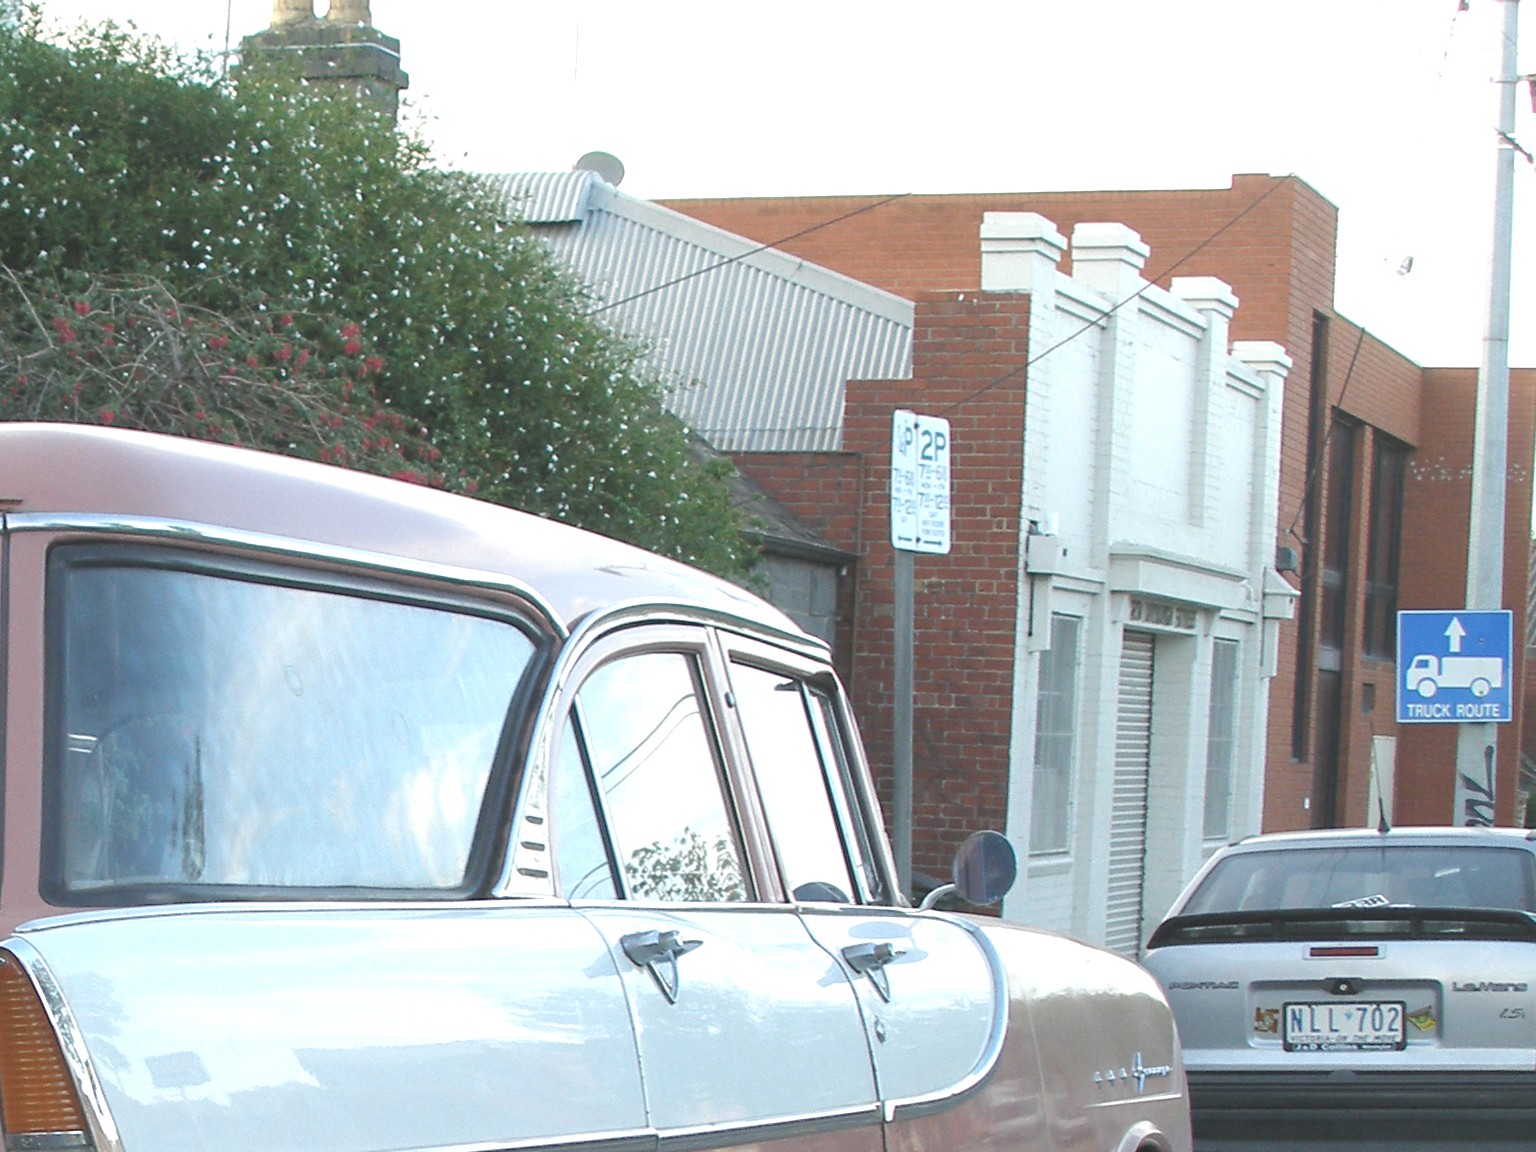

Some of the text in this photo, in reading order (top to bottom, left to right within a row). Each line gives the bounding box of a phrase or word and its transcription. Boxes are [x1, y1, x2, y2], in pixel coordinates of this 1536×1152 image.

[920, 429, 946, 462] 2P
[1407, 703, 1500, 718] TRUCK ROUTE
[1168, 981, 1239, 990] PONTIAC
[1290, 1007, 1400, 1033] NLL 702
